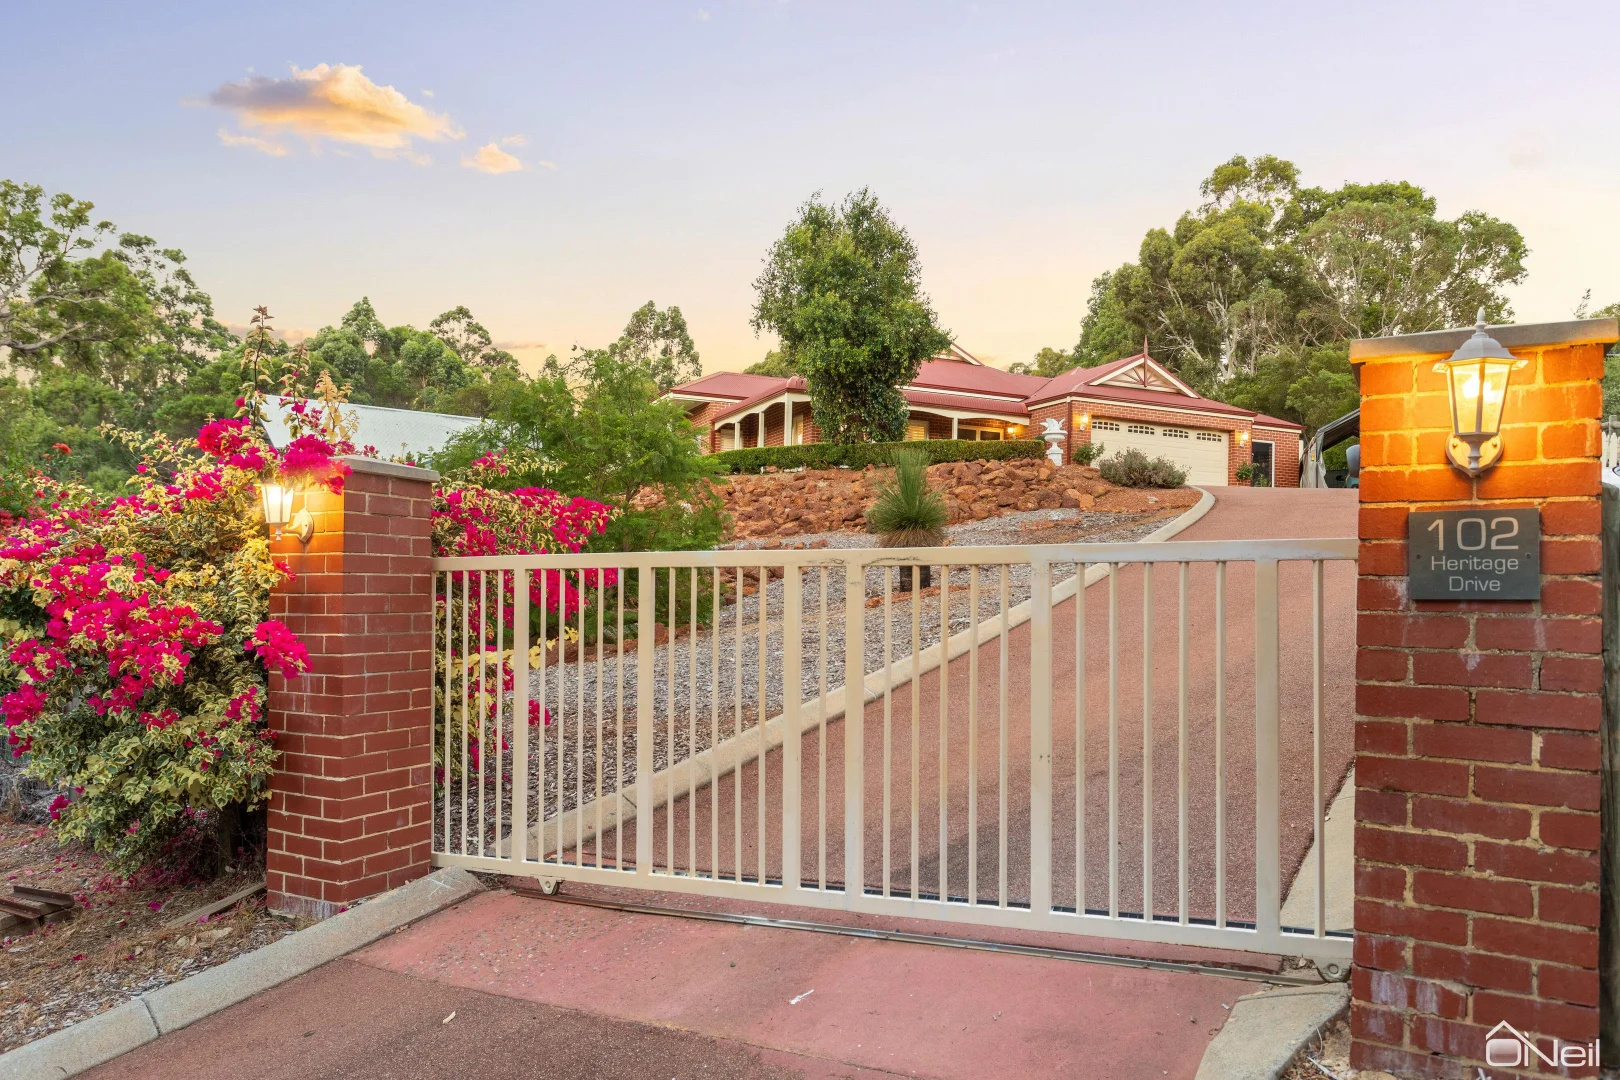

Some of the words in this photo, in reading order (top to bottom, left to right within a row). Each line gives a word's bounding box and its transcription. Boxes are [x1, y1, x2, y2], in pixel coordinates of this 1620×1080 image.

[1427, 517, 1519, 551] 102
[1431, 555, 1519, 575] Heritage
[1449, 576, 1501, 591] Drive
